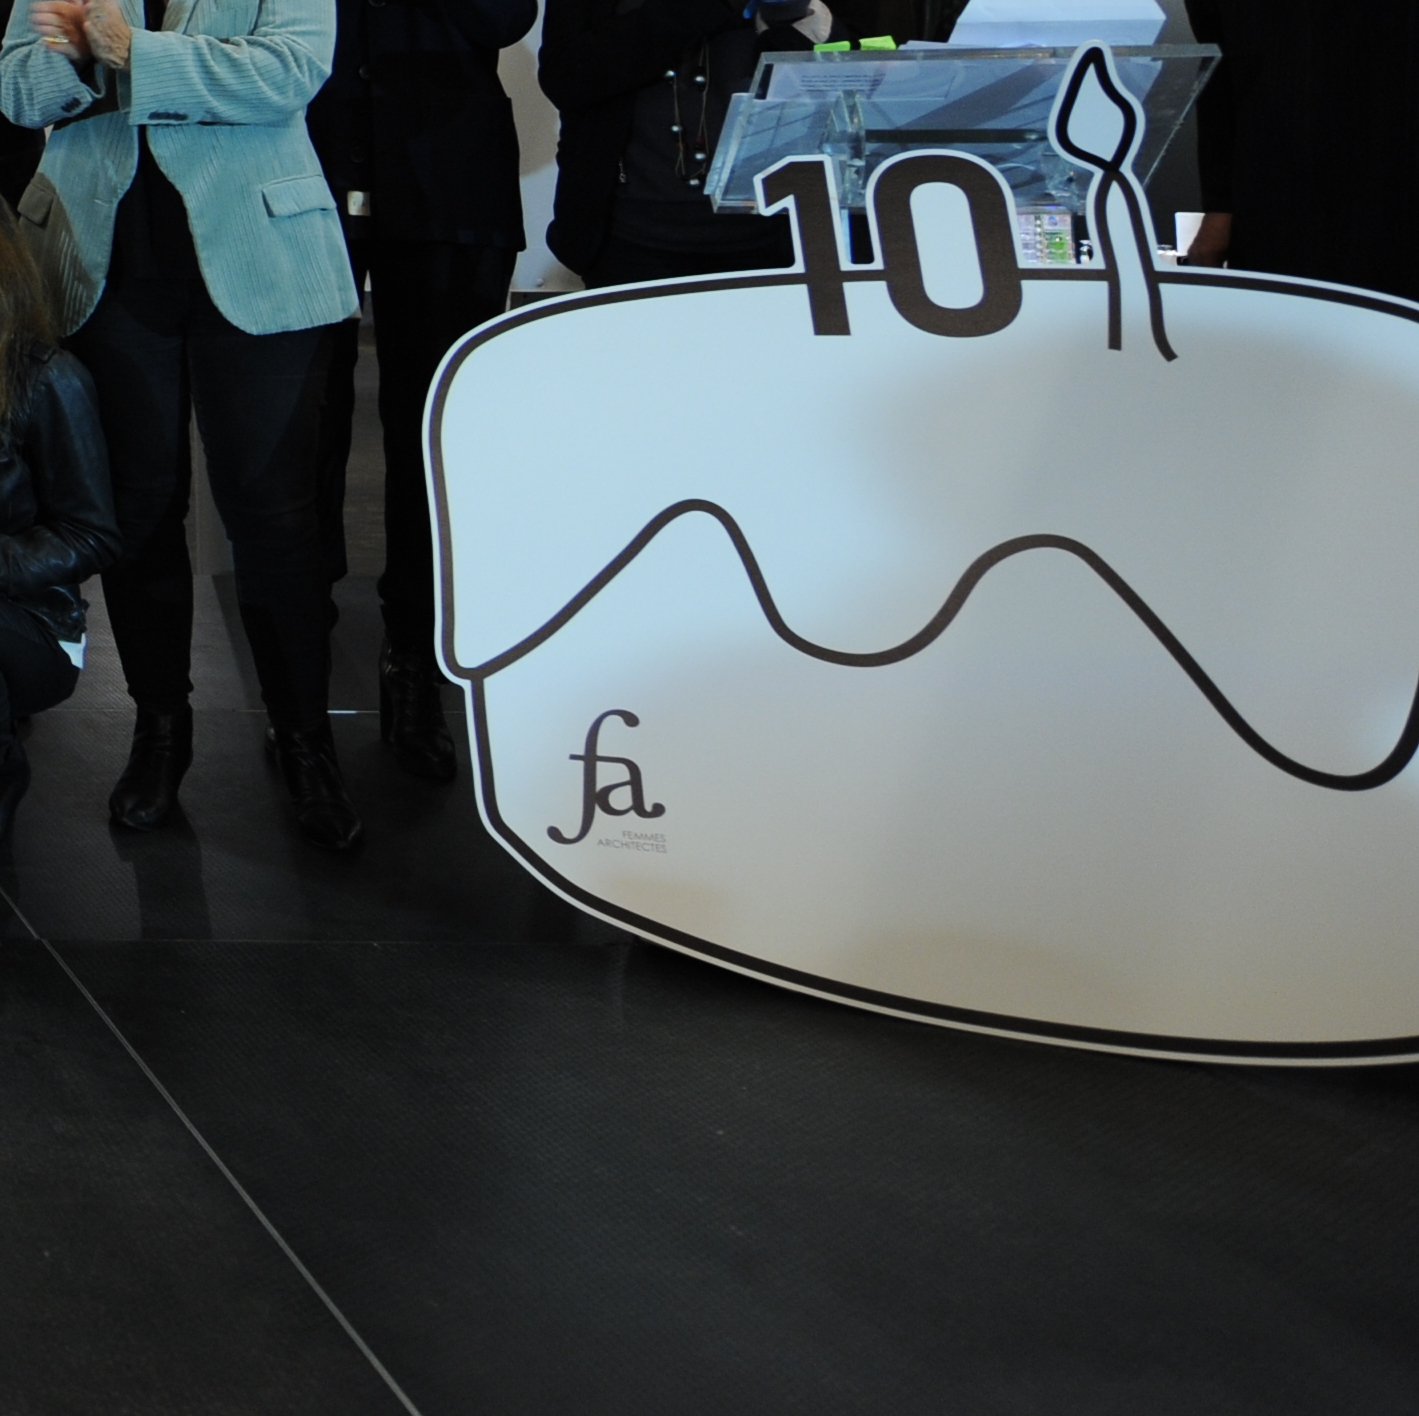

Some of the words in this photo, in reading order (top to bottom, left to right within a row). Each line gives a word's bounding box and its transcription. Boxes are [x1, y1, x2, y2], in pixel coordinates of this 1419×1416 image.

[760, 154, 1023, 338] 10
[547, 709, 666, 844] fa
[597, 839, 666, 853] ARCHITECTES
[623, 830, 666, 842] FEMMES
